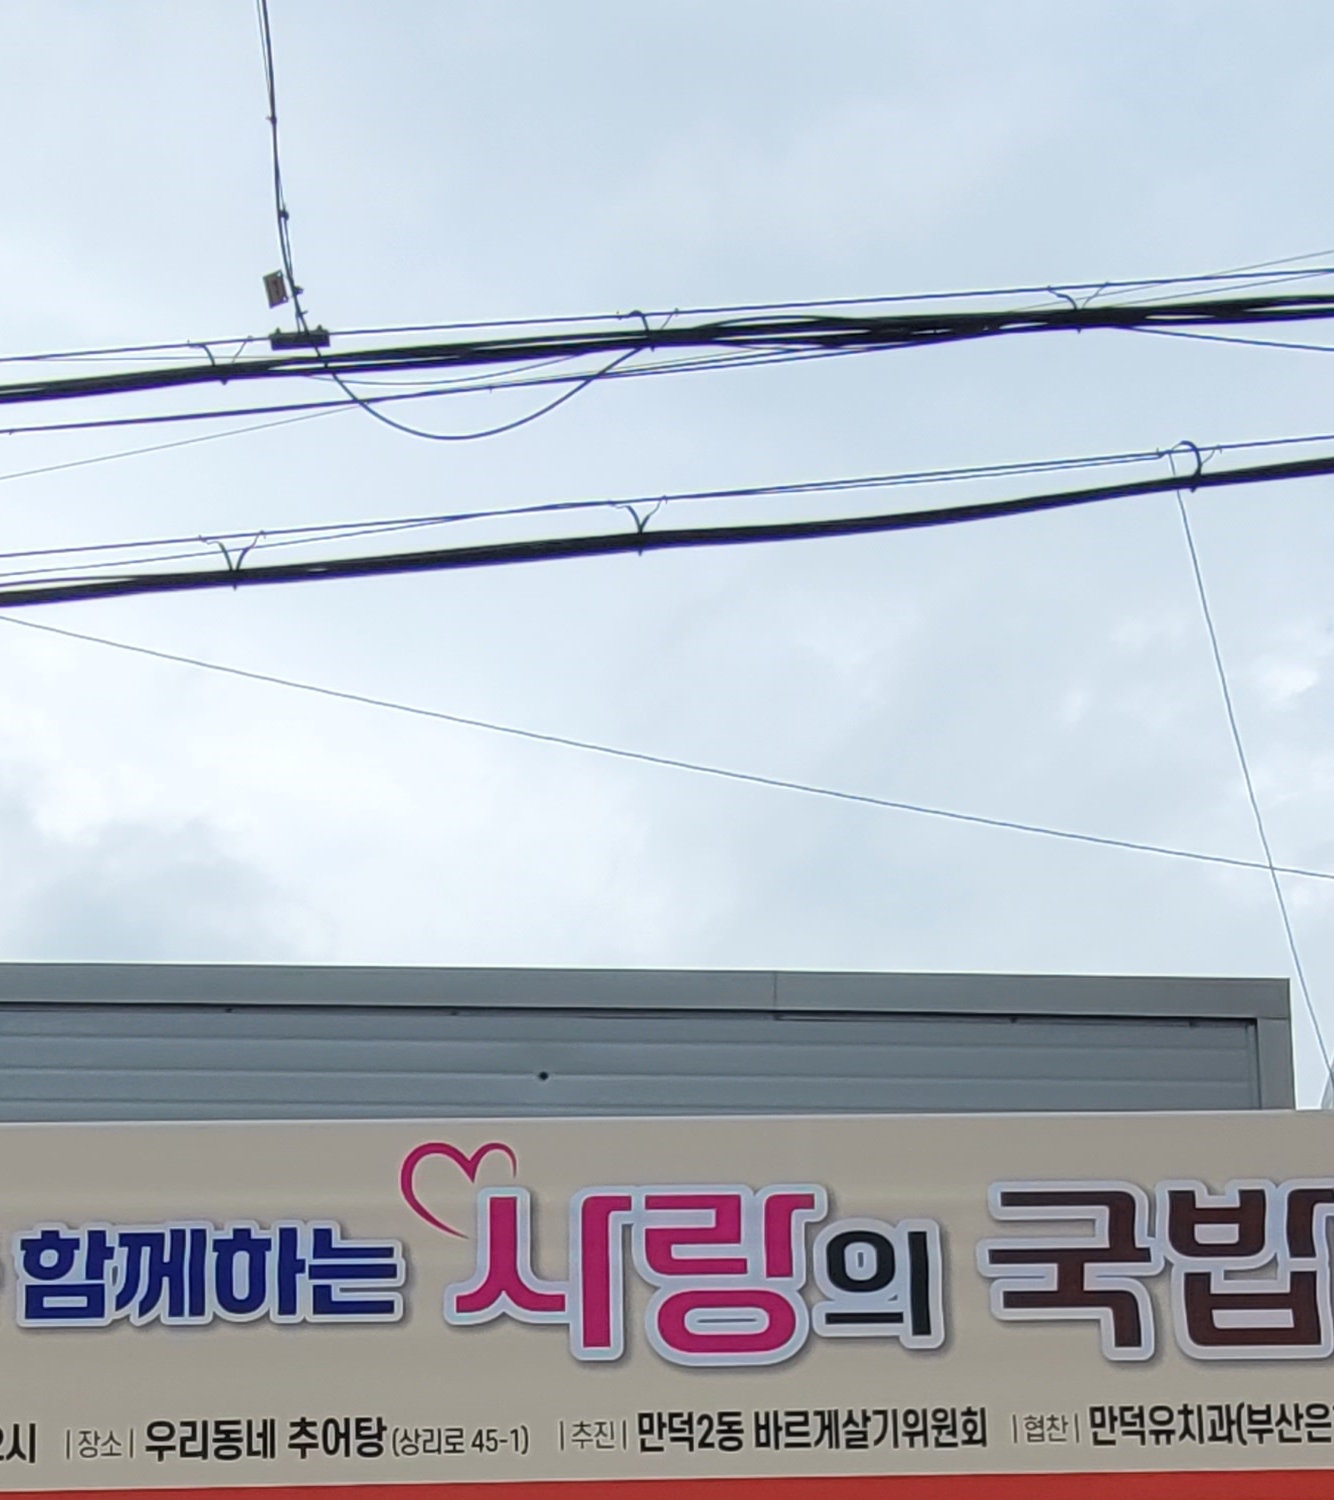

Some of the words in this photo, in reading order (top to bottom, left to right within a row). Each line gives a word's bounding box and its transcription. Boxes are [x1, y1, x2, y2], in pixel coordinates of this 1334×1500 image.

[20, 1227, 398, 1322] 함께하는
[454, 1190, 928, 1355] 사랑의
[144, 1416, 278, 1463] 우리동네
[470, 1421, 531, 1457] 45-1)
[636, 1411, 744, 1454] 만덕2동
[753, 1406, 988, 1452] 바르게살기위원회
